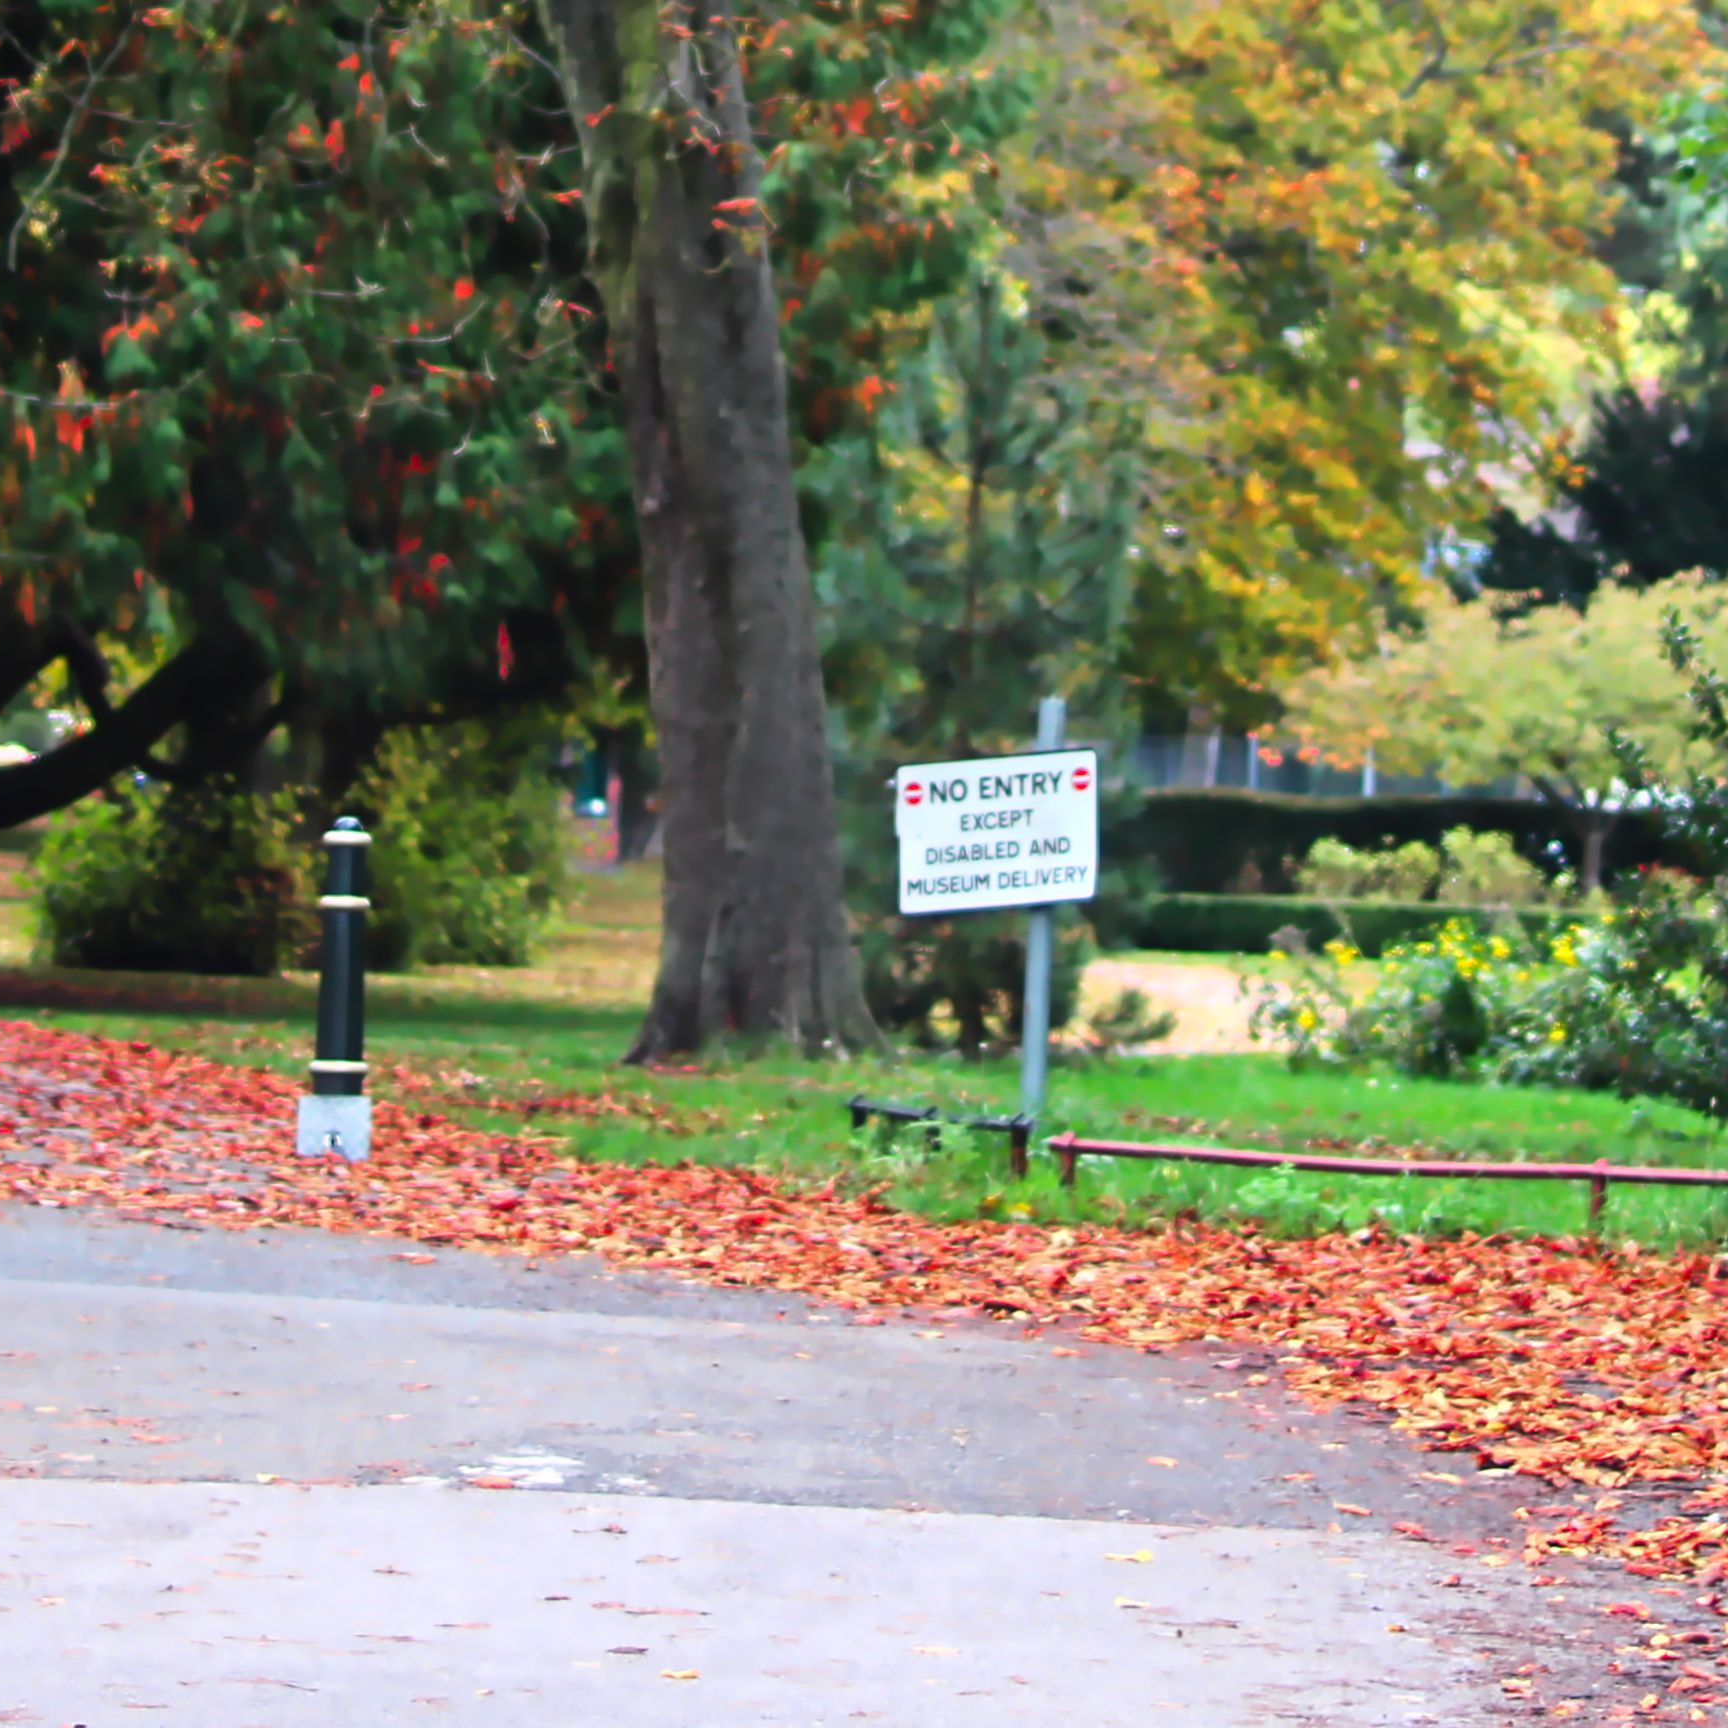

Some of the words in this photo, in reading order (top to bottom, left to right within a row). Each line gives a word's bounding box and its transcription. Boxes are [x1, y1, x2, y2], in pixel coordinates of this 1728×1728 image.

[929, 779, 968, 804] NO
[979, 772, 1063, 800] ENTRY
[960, 809, 1034, 832] EXCEPT
[925, 841, 1020, 865] DISABLED
[1028, 837, 1070, 856] AND
[907, 874, 990, 896] MUSEUM
[998, 866, 1088, 890] DELIVERY
